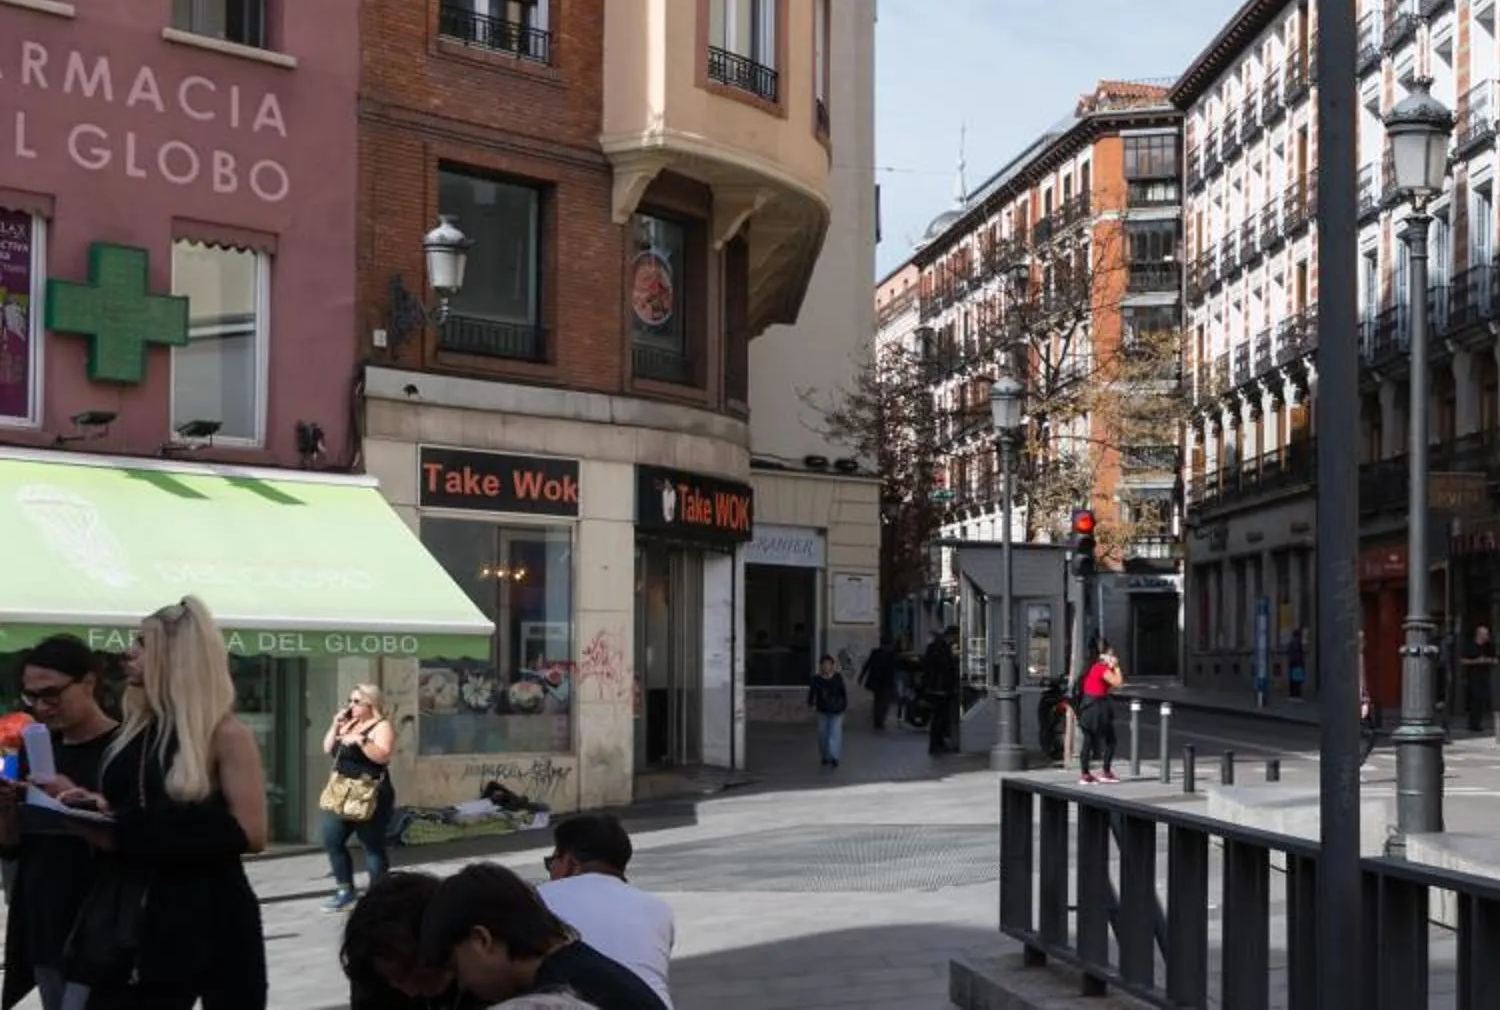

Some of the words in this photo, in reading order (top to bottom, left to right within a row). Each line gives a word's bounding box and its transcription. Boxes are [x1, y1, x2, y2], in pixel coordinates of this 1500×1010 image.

[0, 41, 287, 138] RMACIA
[68, 123, 289, 201] GLOBO
[423, 463, 500, 498] Take
[513, 469, 578, 503] Wok
[677, 484, 712, 525] Take
[714, 492, 750, 531] WOK
[257, 632, 311, 653] DEL
[325, 633, 419, 654] GLOBO
